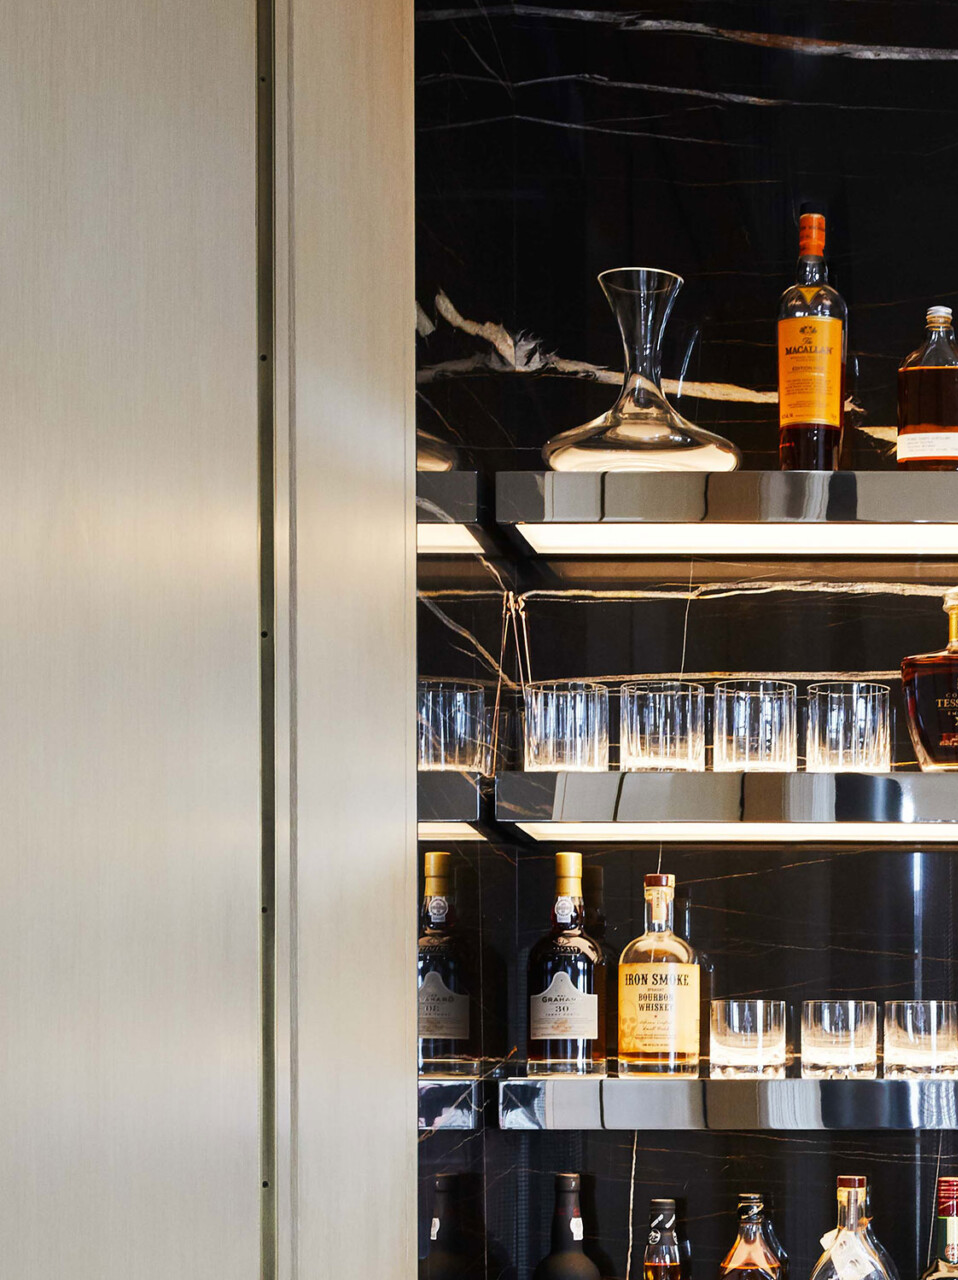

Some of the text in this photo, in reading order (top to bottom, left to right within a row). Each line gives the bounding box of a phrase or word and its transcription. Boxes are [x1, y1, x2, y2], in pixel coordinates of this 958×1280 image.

[785, 345, 834, 355] MACALLAN
[625, 973, 689, 986] IRON SMOKE
